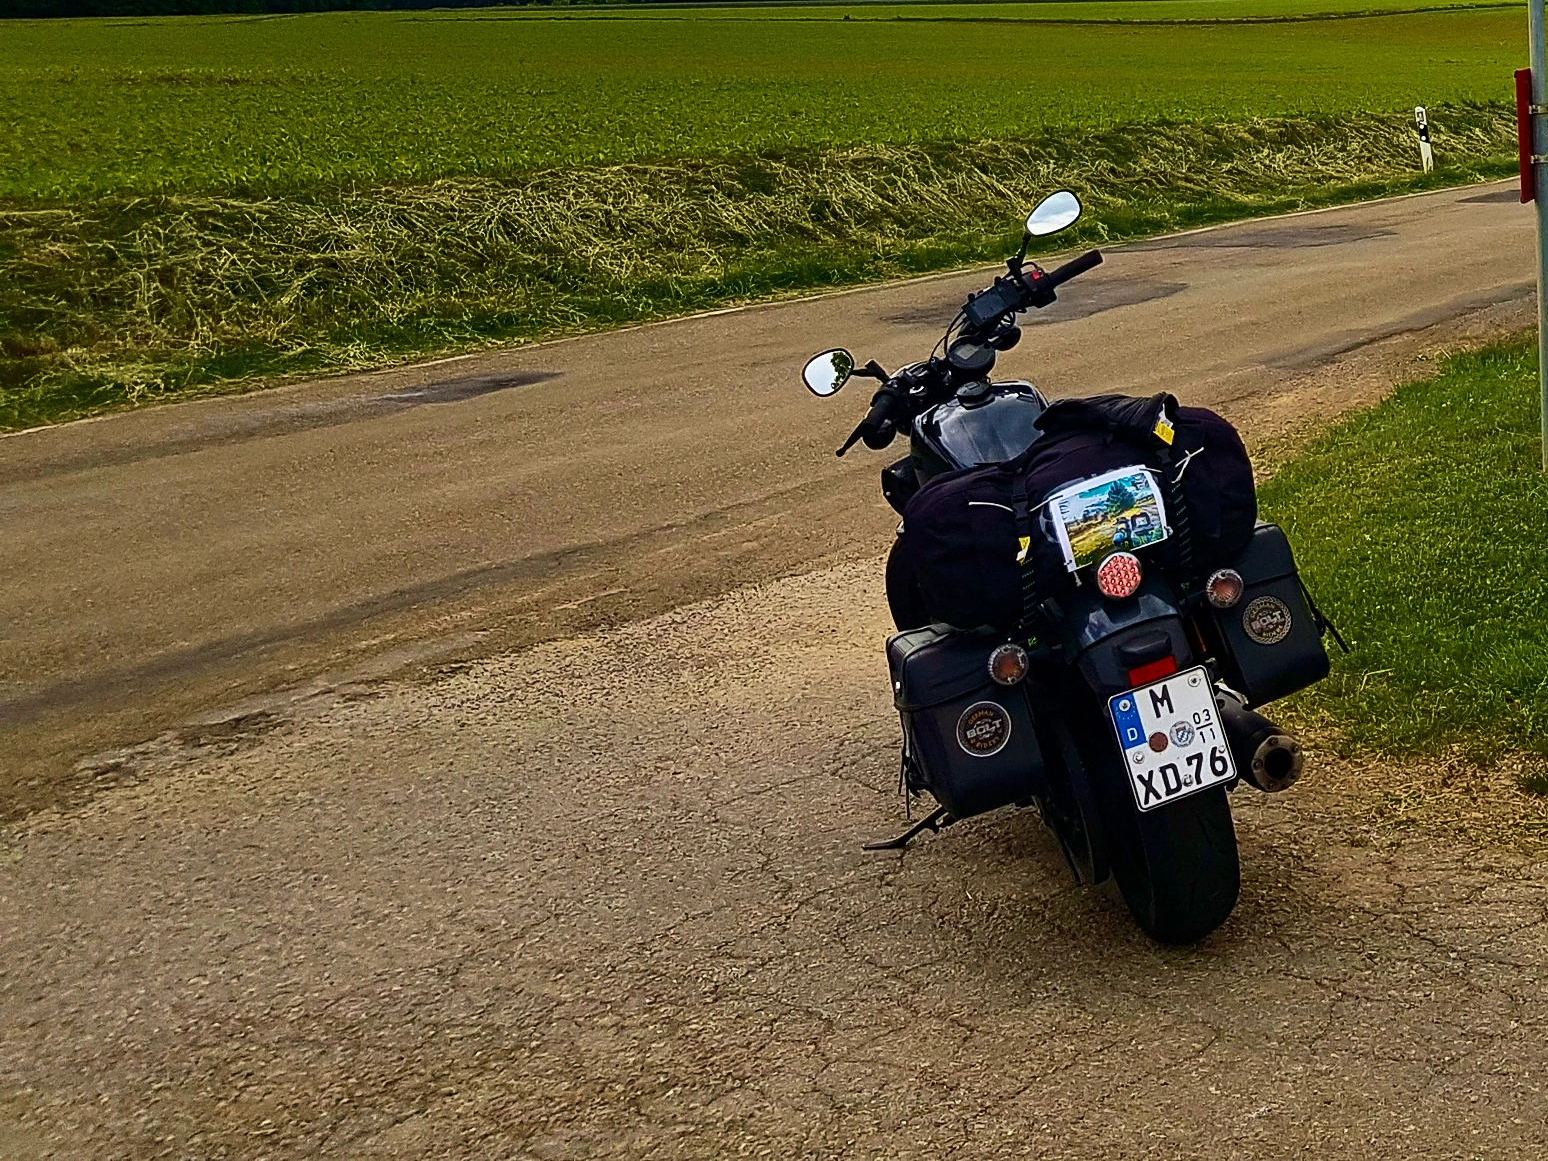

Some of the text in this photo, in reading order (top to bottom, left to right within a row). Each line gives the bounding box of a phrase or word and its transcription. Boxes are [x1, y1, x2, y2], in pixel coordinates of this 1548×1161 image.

[1149, 684, 1175, 718] M
[1192, 708, 1212, 725] 03
[966, 718, 1002, 739] BOLT
[1126, 727, 1138, 742] D
